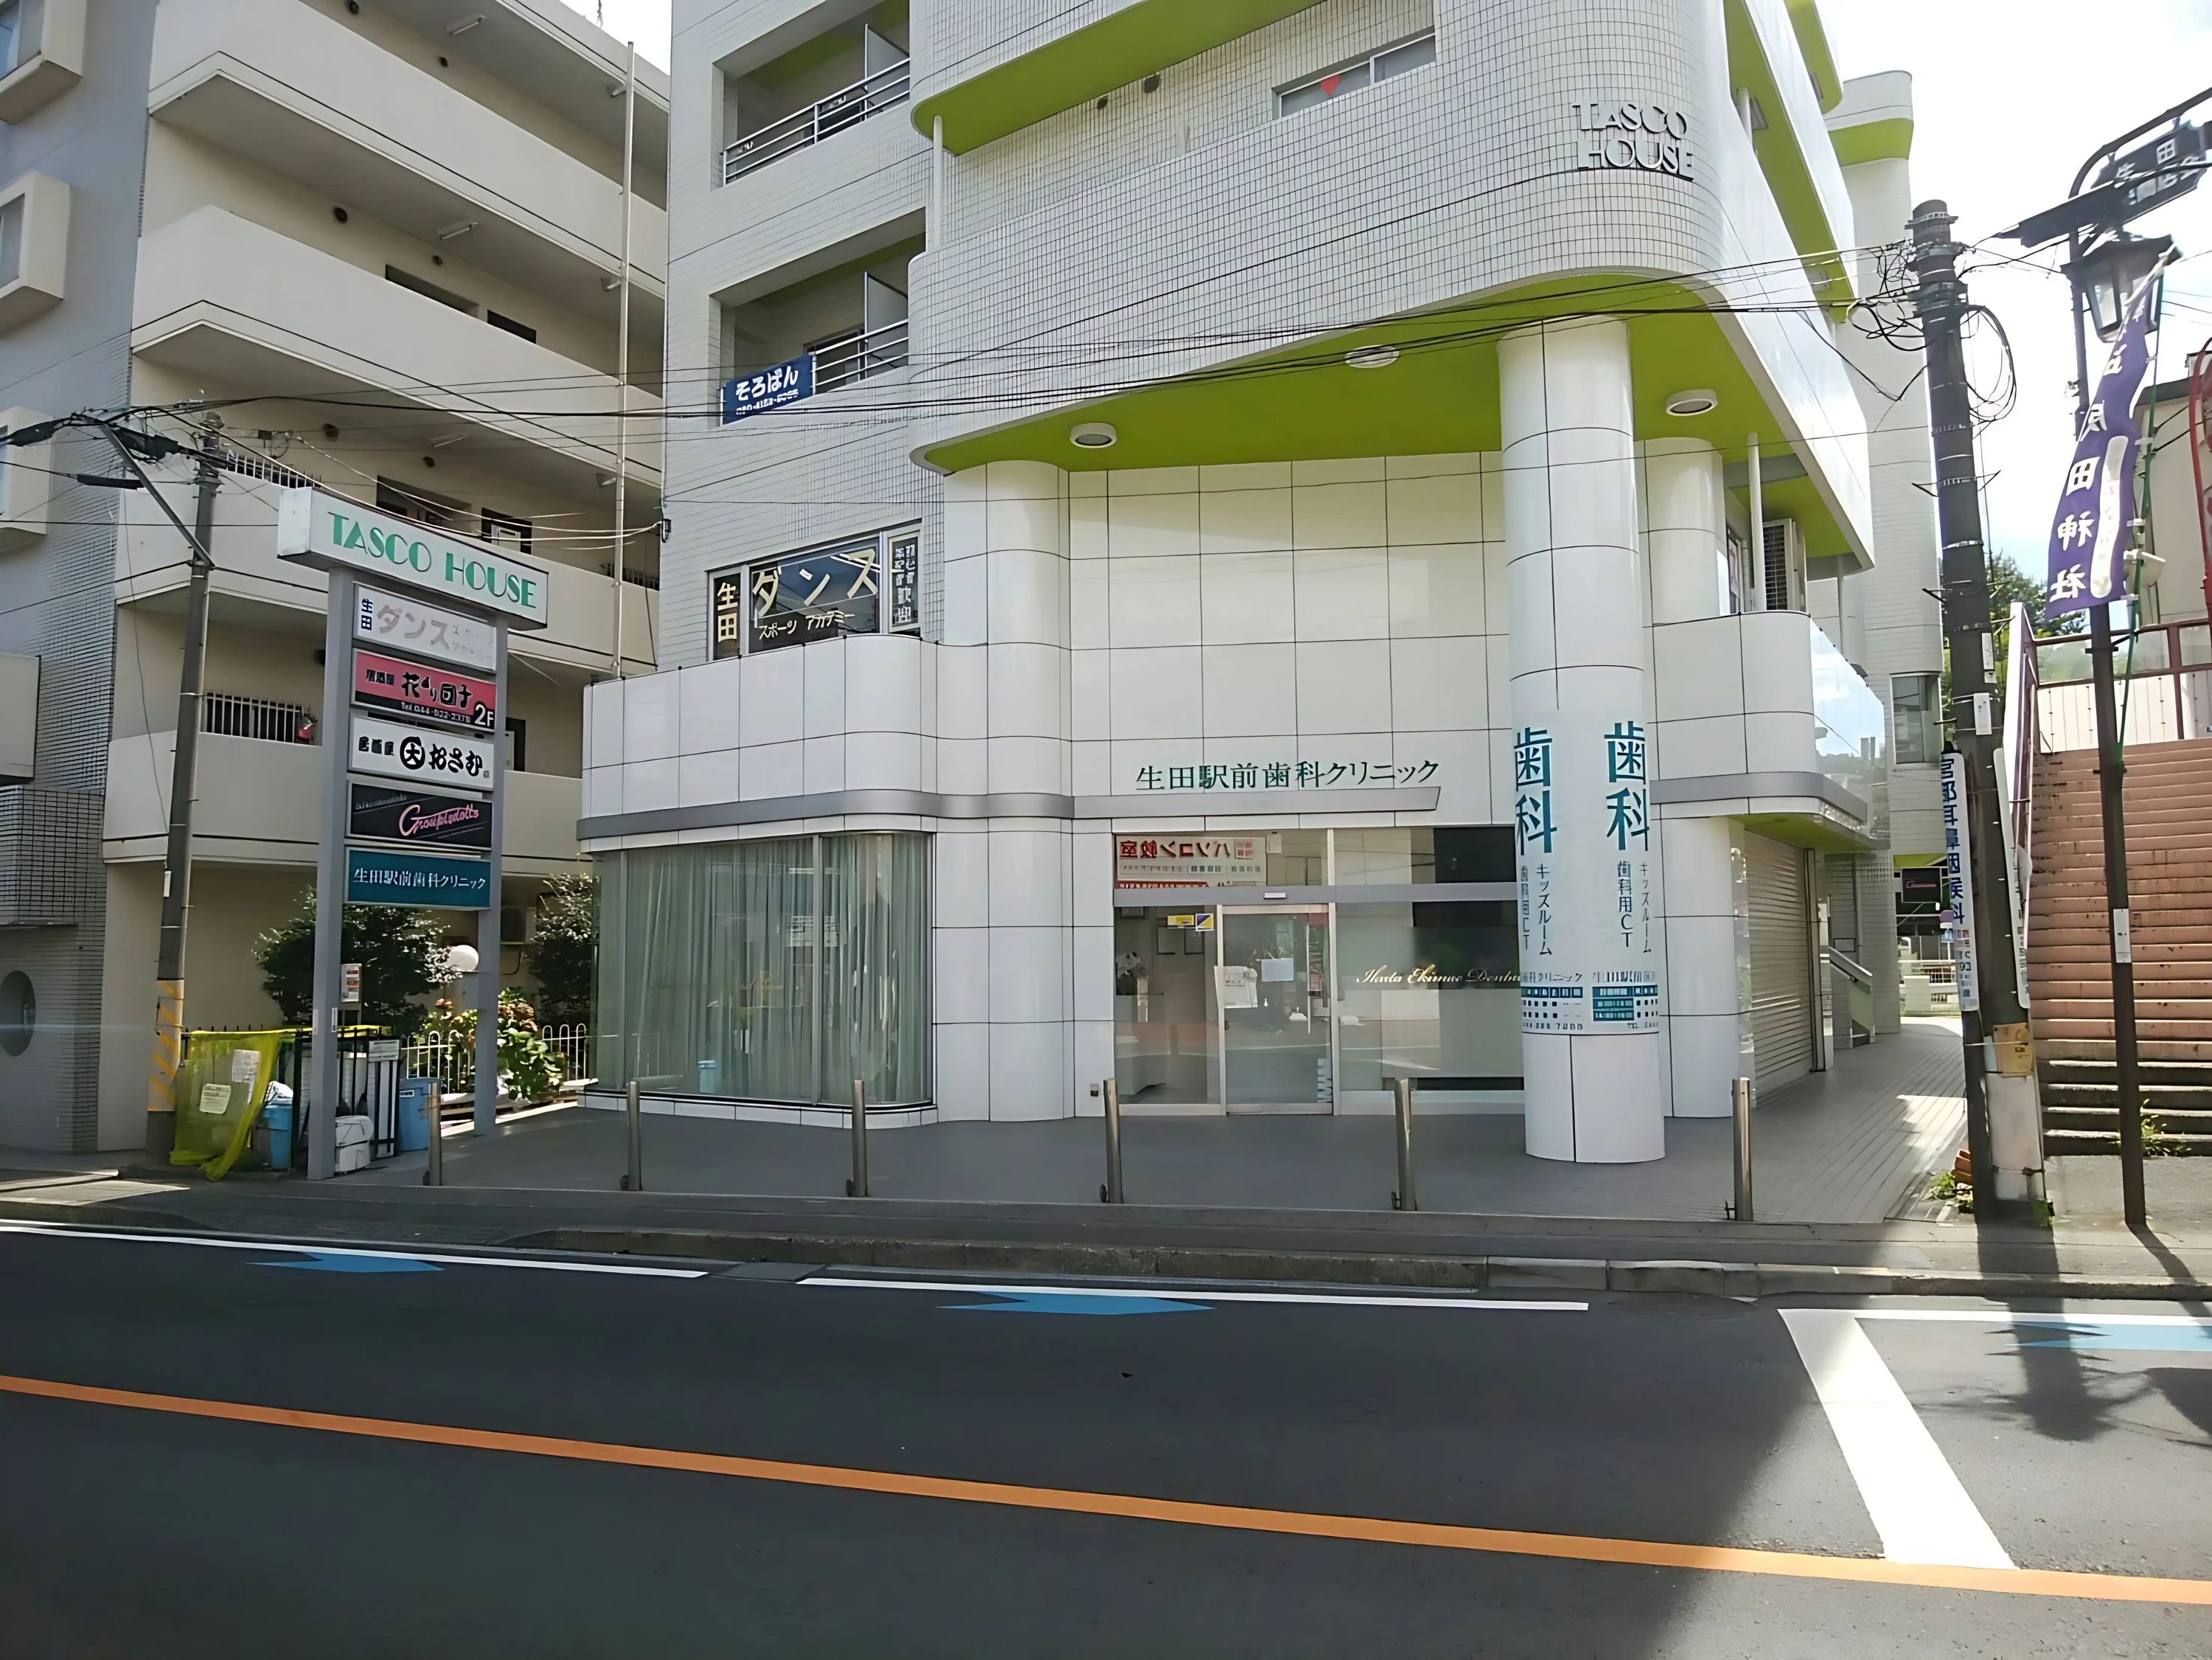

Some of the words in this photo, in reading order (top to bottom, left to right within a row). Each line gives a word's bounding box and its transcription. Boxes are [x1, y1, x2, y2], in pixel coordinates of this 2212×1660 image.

[1572, 101, 1687, 140] TASCO
[1577, 138, 1694, 181] HOUSE
[736, 366, 799, 401] そろばん
[327, 511, 432, 572] TASCO
[445, 552, 537, 609] HOUSE
[752, 548, 878, 619] ダンス
[377, 605, 450, 650] ダンス
[717, 582, 738, 643] 生田
[759, 620, 797, 639] スポーツ
[474, 703, 495, 727] 2F
[428, 743, 483, 777] おさむ
[1135, 760, 1439, 790] 生田駅前歯科クリニック
[1514, 727, 1557, 855] 歯科
[1604, 720, 1650, 851] 歯科
[354, 867, 486, 889] 生田駅前歯科クリニック
[1536, 863, 1552, 956] キッズルーム
[1617, 860, 1632, 948] 歯科用CT
